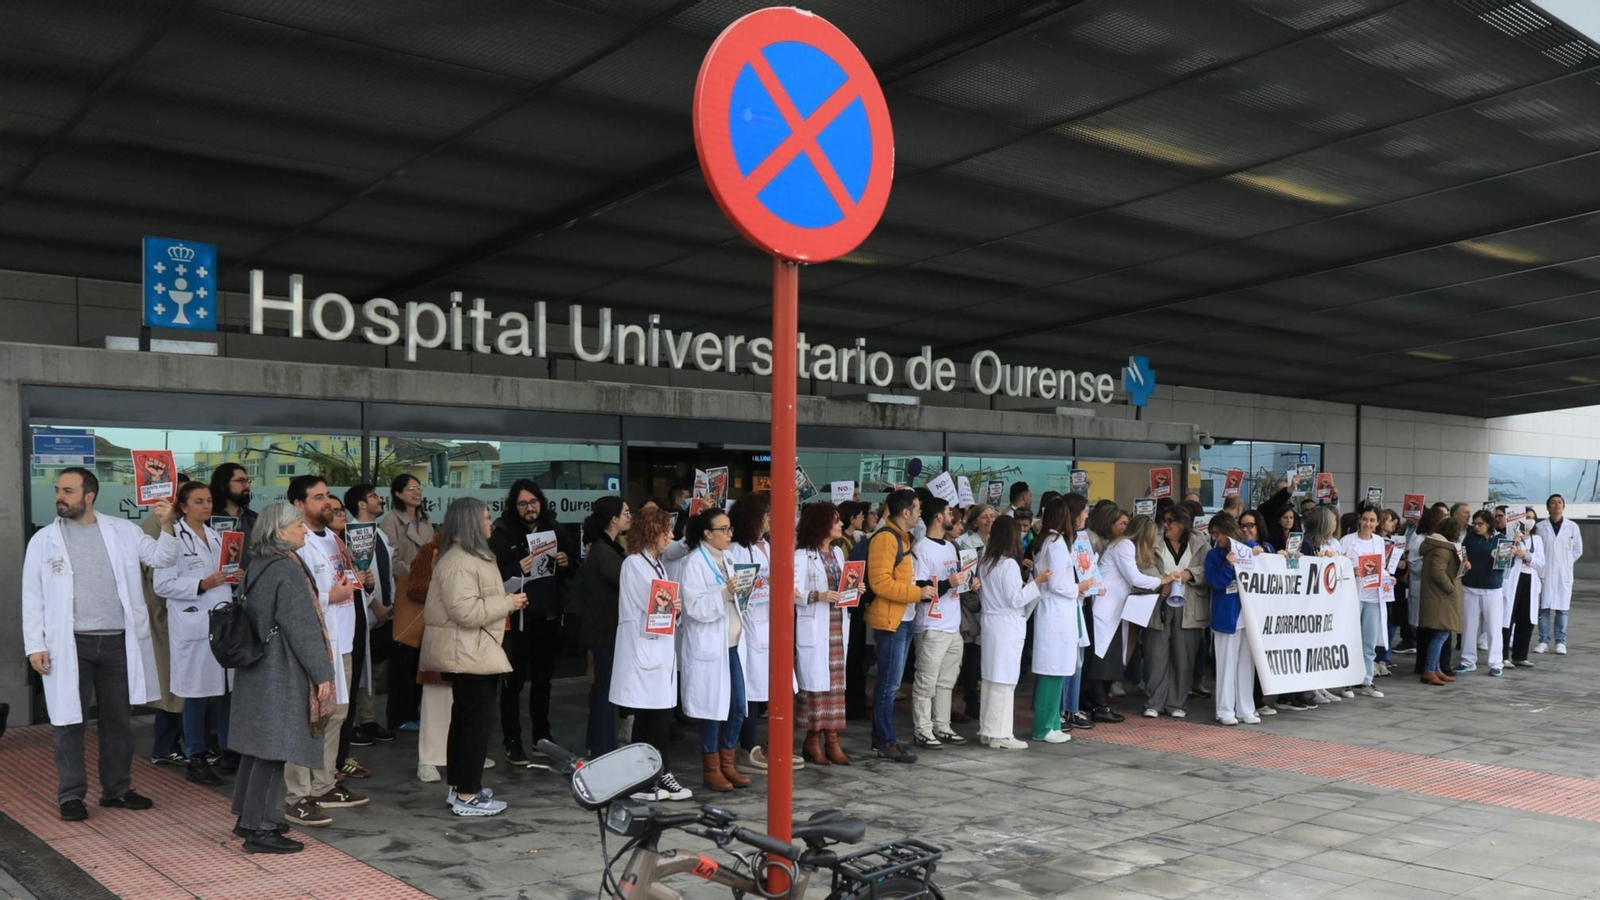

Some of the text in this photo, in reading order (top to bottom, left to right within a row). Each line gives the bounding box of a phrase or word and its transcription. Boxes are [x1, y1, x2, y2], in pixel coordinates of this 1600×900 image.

[248, 269, 1114, 404] Hospital Universtario de Ourense
[1238, 571, 1283, 595] GALICIA
[1262, 614, 1333, 635] AL BORRADOR DEL
[1305, 644, 1350, 673] MARCO
